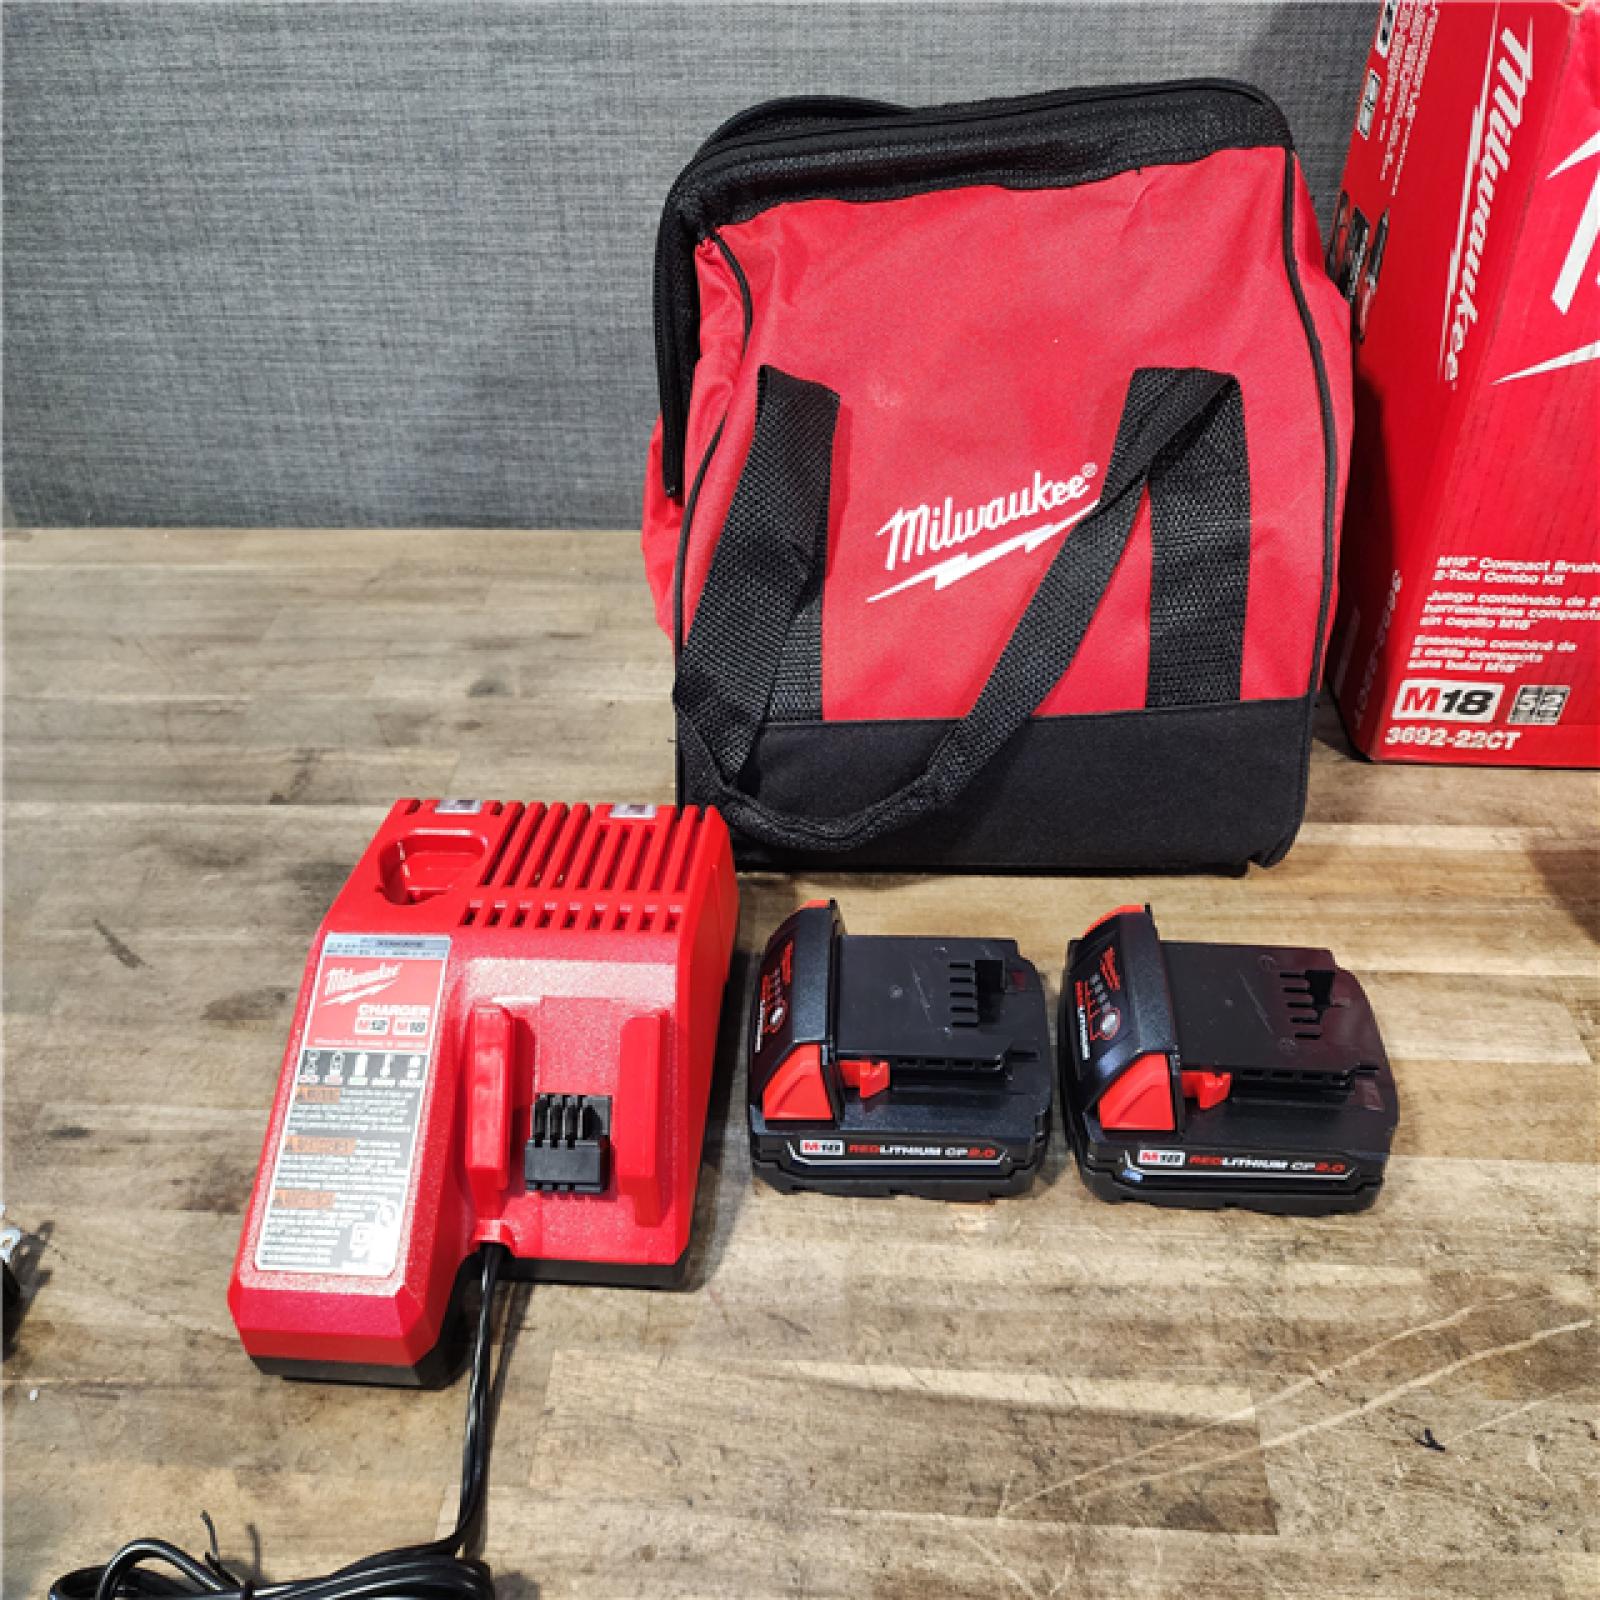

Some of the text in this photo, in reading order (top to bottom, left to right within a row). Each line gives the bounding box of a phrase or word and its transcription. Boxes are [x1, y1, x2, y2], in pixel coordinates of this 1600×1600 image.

[1480, 557, 1550, 572] Compact
[1484, 571, 1539, 584] Combo
[1477, 593, 1563, 606] combinado
[1565, 595, 1586, 607] de
[1401, 687, 1495, 716] M18
[1384, 726, 1521, 750] 3692-22CT
